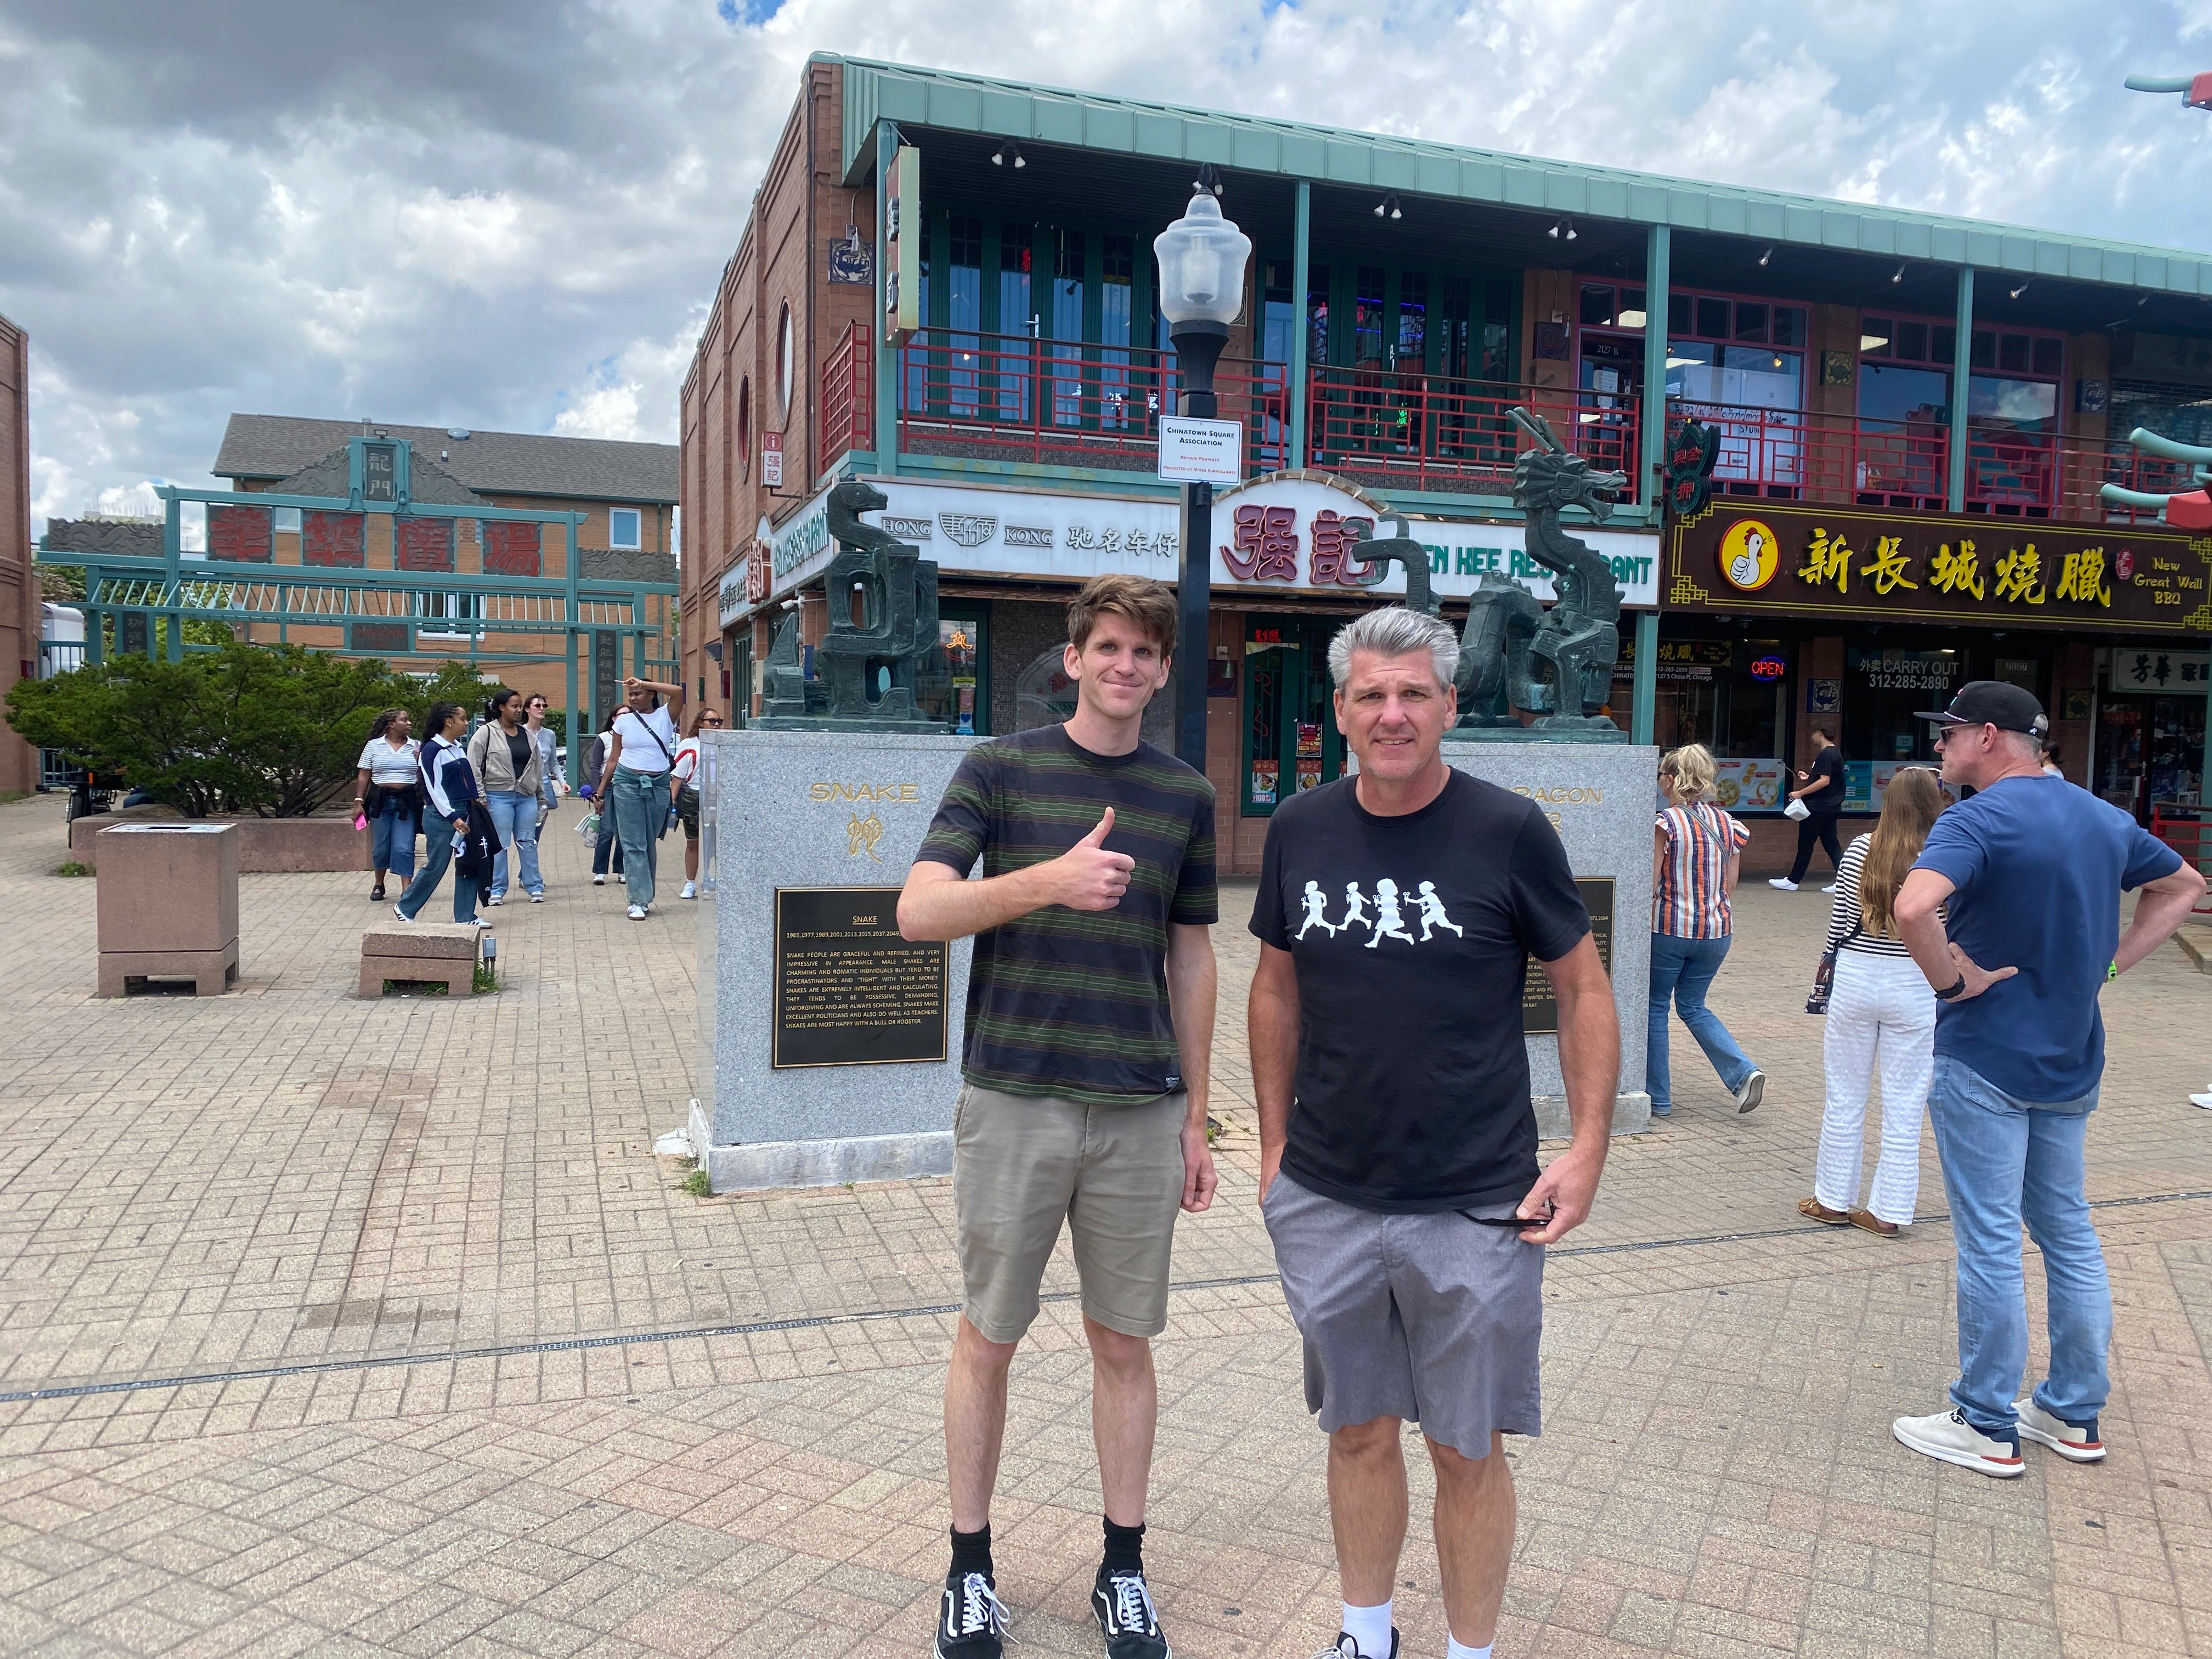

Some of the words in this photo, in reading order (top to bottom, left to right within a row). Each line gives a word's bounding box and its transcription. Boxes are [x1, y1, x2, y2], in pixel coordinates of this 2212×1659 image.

[1597, 345, 1611, 354] 2127
[1167, 427, 1206, 436] CHINATOWN
[1180, 437, 1222, 446] ASSOCIATION
[882, 520, 931, 535] HONG
[1005, 528, 1052, 544] KONG
[1066, 526, 1179, 557] 驰名车仔
[1456, 546, 1501, 575] KEE
[2152, 556, 2180, 572] New
[2133, 573, 2170, 588] Great
[2177, 576, 2203, 589] Wall
[2154, 591, 2181, 605] BBQ
[1752, 661, 1784, 675] OPEN
[1860, 658, 1882, 672] 外卖
[1883, 659, 1929, 674] CARRY
[1932, 662, 1960, 675] OUT
[2007, 662, 2027, 670] 2127
[1870, 674, 1949, 690] 312-285-2890
[809, 782, 920, 803] SNAKE
[1504, 787, 1602, 804] RAGON
